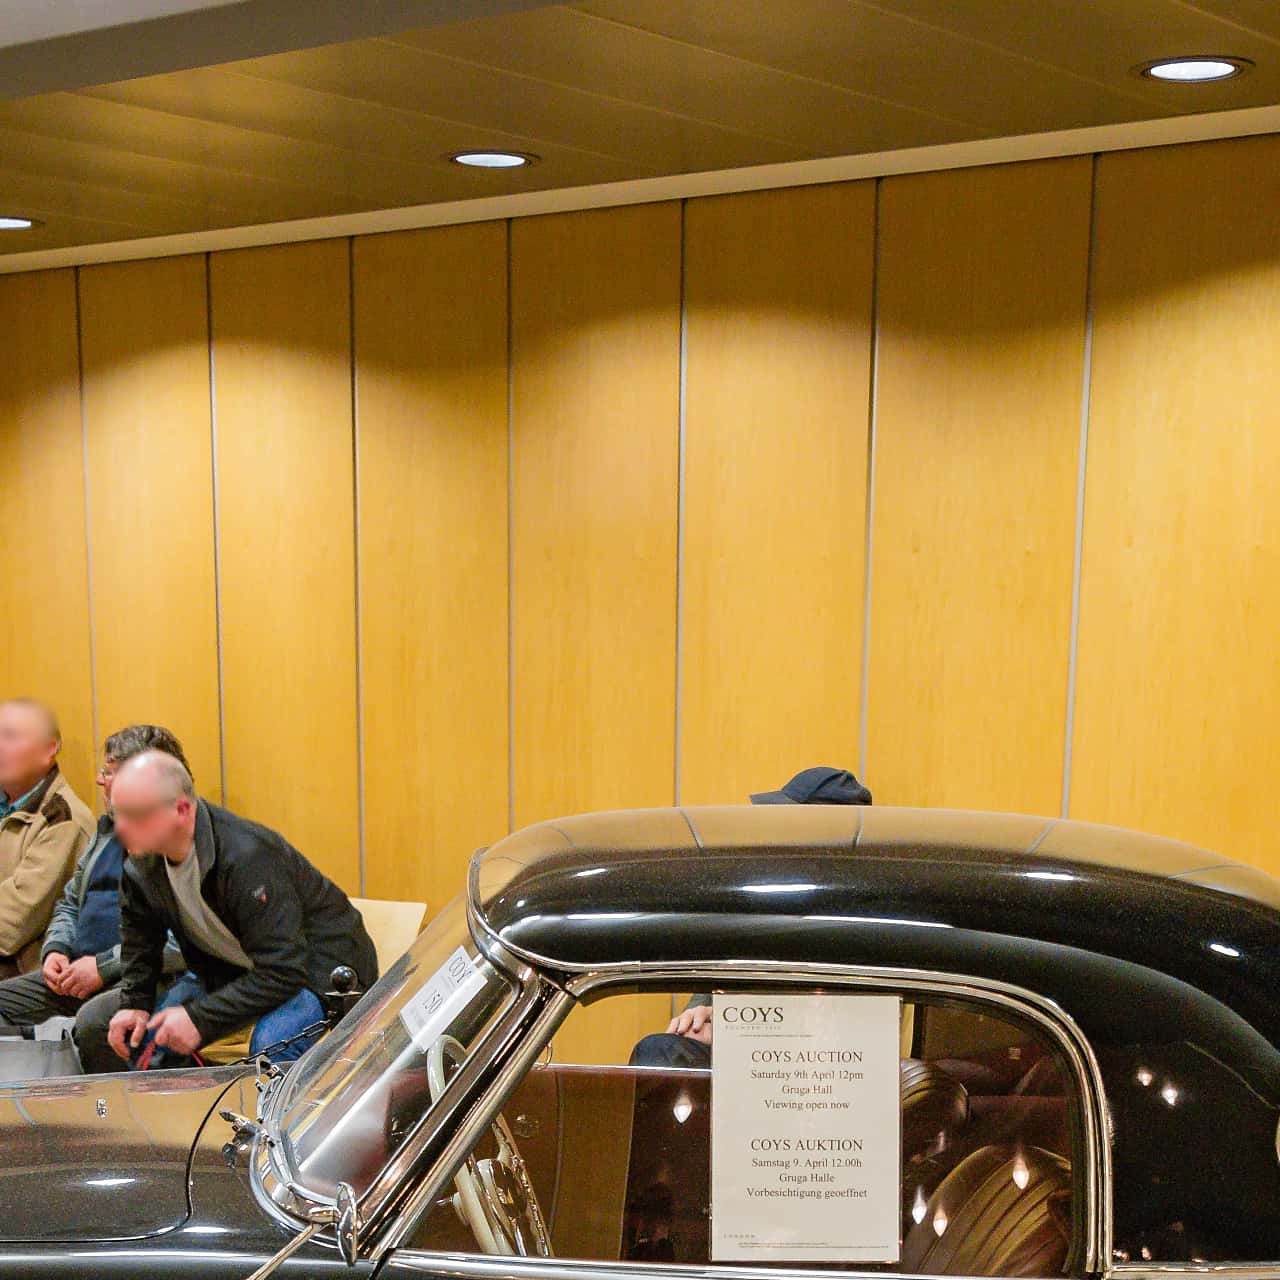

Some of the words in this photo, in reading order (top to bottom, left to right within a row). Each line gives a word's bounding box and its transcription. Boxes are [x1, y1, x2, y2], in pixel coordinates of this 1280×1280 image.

[722, 1006, 784, 1022] COYS
[751, 1050, 791, 1063] COYS
[796, 1050, 863, 1063] AUCTION
[751, 1070, 791, 1081] Saturday
[794, 1070, 808, 1079] 9th
[811, 1070, 835, 1081] April
[839, 1070, 864, 1081] 12pm
[782, 1085, 809, 1096] Gruga
[813, 1085, 832, 1094] Hall
[764, 1099, 803, 1111] Viewing
[806, 1102, 827, 1112] open
[751, 1139, 791, 1151] COYS
[795, 1139, 863, 1151] AUKTION
[752, 1158, 790, 1169] Samstag
[793, 1158, 801, 1168] 9.
[804, 1158, 828, 1169] April
[832, 1158, 862, 1168] 12.00h
[779, 1173, 807, 1184] Gruga
[811, 1173, 835, 1183] Halle
[747, 1187, 822, 1199] Vorbesichtigung
[824, 1188, 868, 1199] geoeffnet
